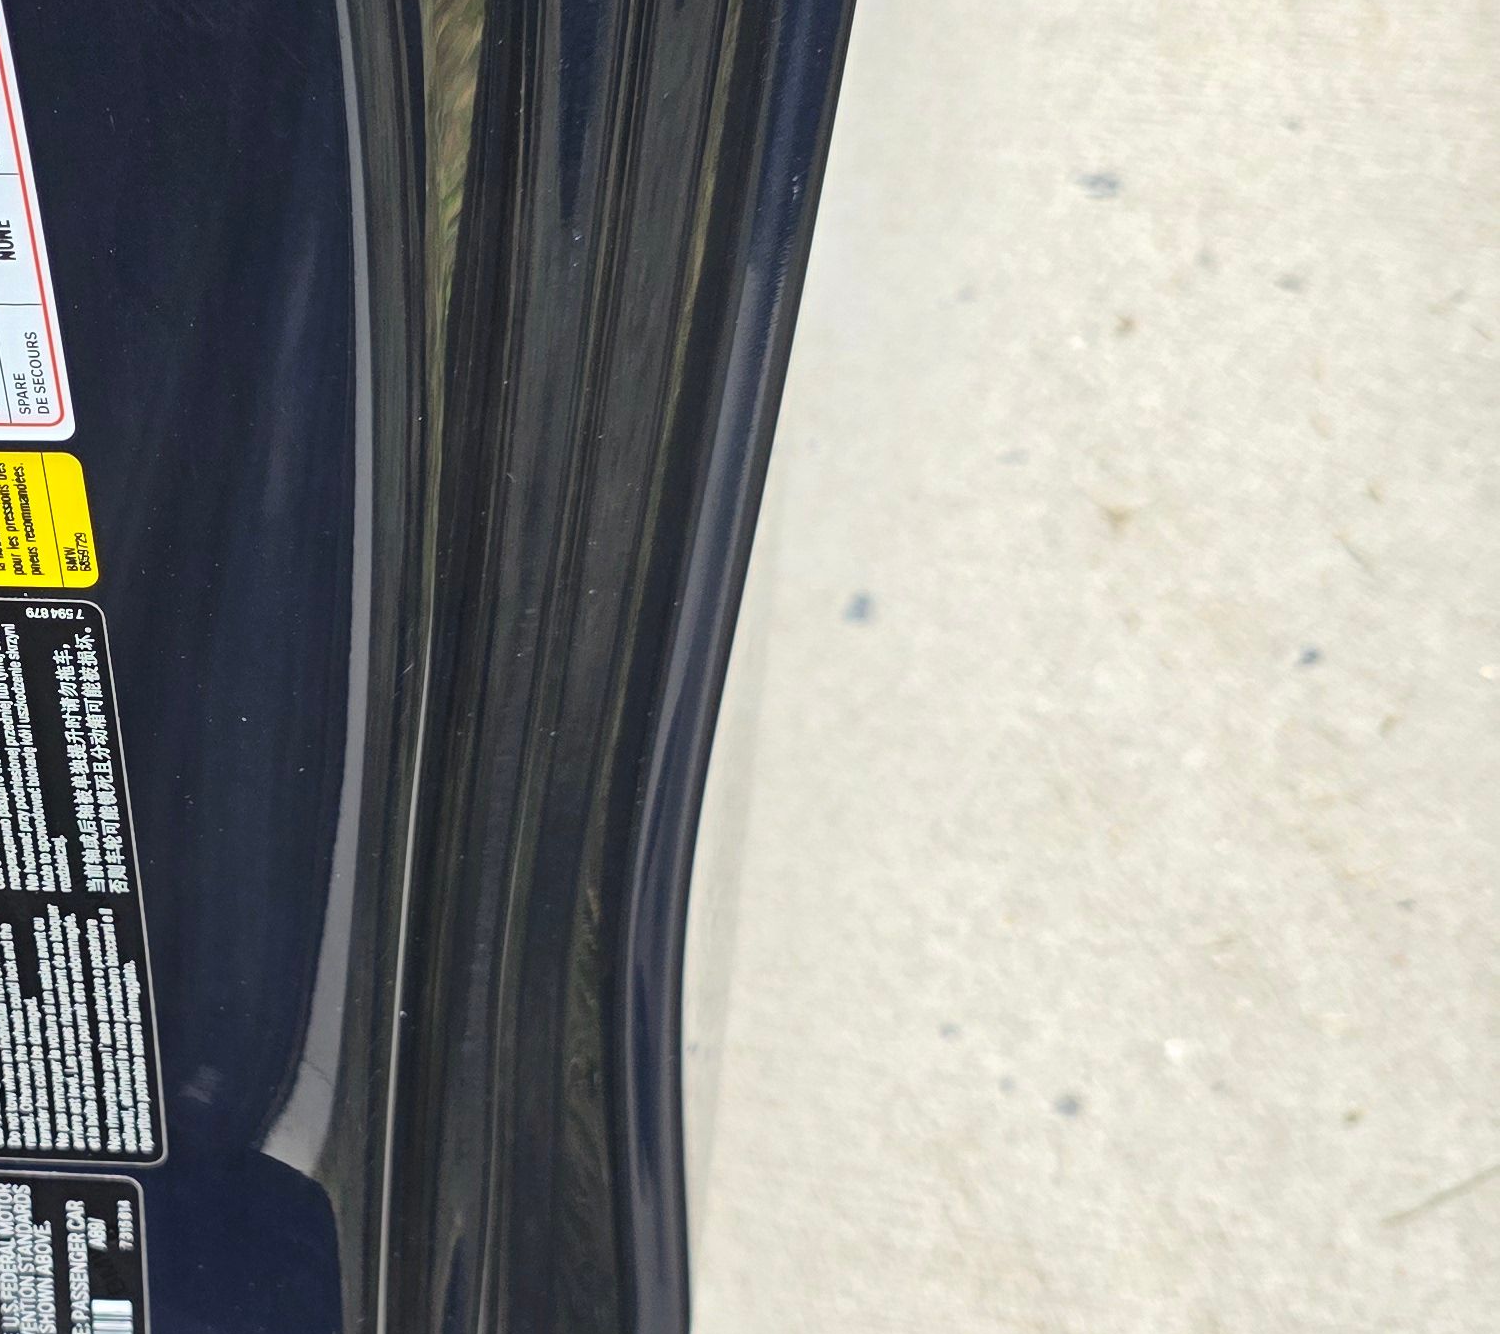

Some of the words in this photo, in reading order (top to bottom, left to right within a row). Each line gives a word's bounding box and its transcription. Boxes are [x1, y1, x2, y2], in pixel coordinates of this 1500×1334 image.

[23, 330, 48, 395] SECOURS
[11, 372, 33, 416] SPARE
[34, 396, 51, 416] DE
[63, 546, 79, 572] BMW
[65, 1199, 86, 1229] CAR
[67, 1233, 90, 1320] PASSENGER
